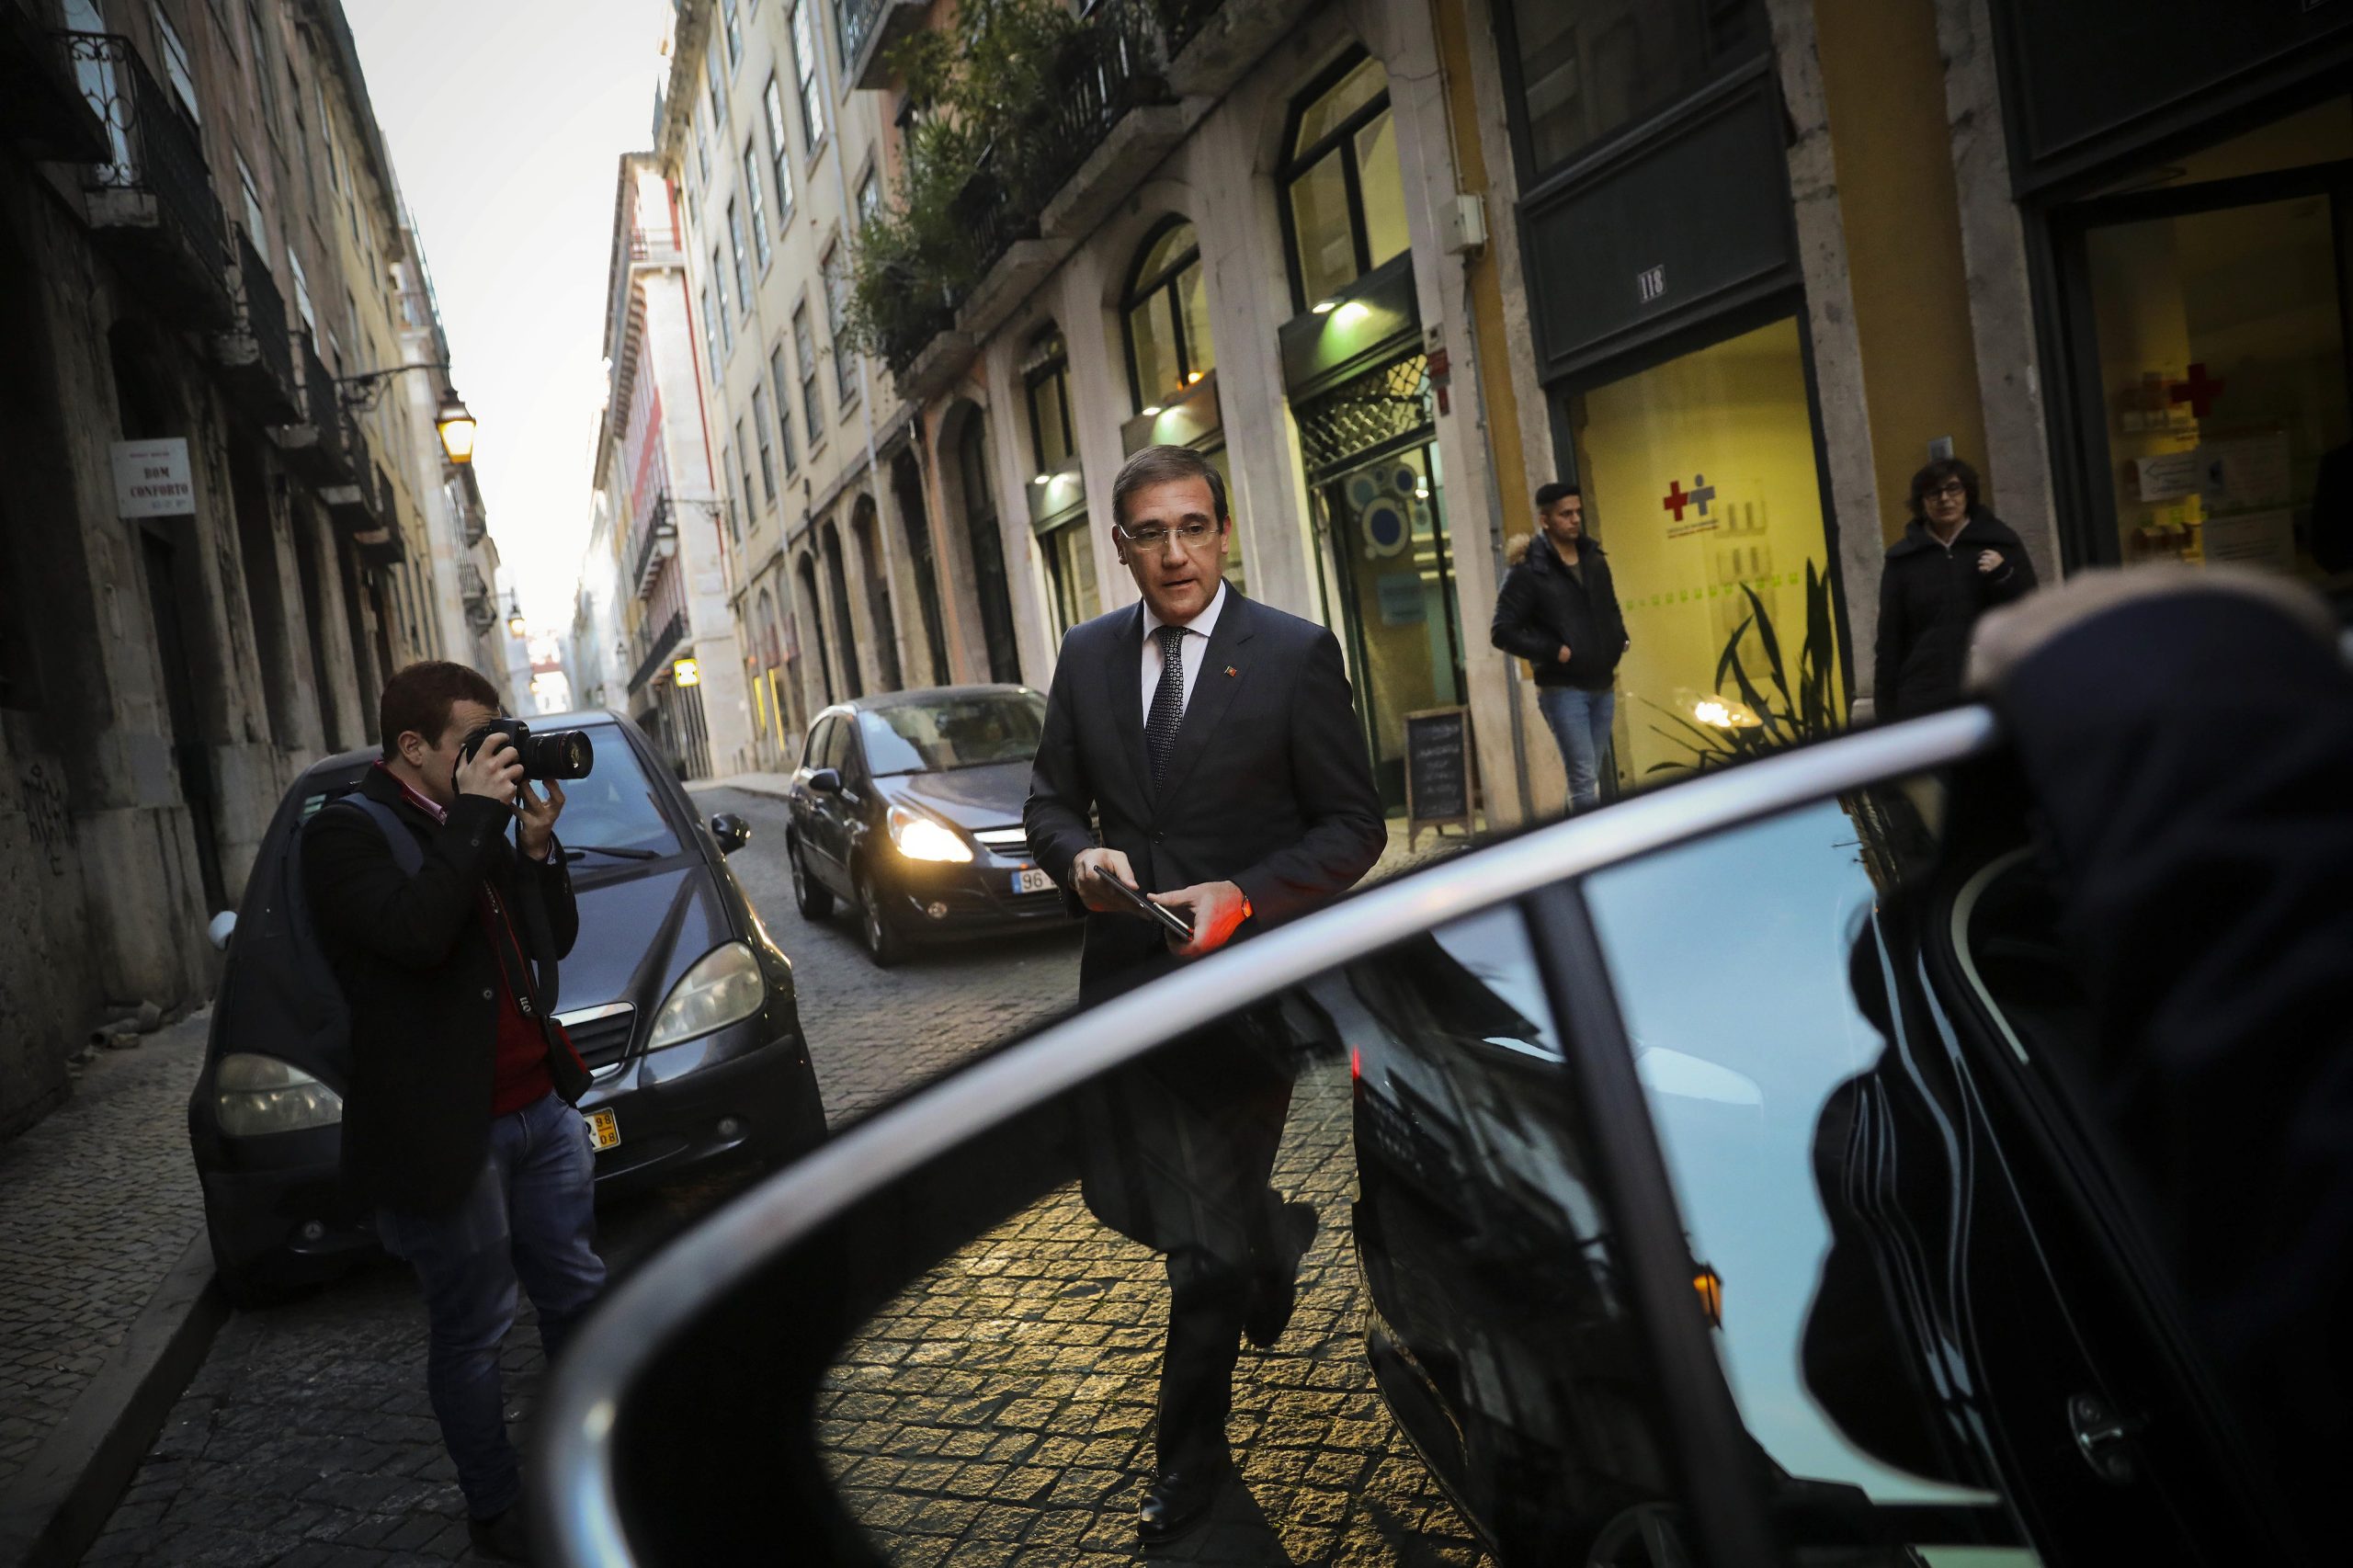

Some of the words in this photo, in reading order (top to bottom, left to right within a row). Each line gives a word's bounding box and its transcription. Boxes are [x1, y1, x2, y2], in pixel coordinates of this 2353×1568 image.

[1641, 269, 1664, 299] 118
[143, 466, 170, 480] BOM
[130, 483, 189, 497] CONFORTO
[596, 1114, 612, 1128] 98
[600, 1132, 615, 1145] 08
